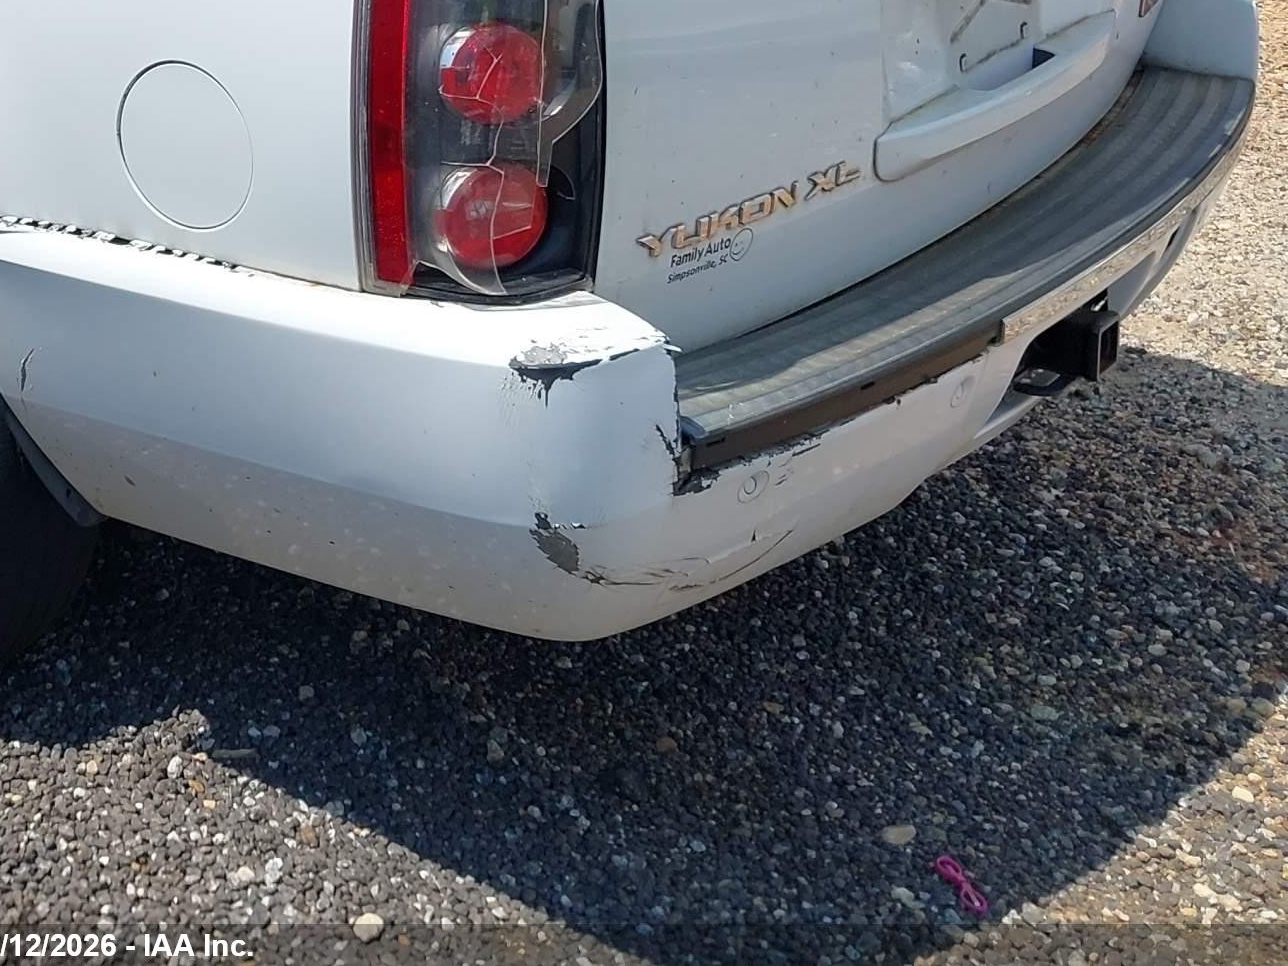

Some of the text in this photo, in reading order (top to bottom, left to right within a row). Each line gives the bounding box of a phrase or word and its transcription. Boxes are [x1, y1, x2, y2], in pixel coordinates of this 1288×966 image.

[635, 160, 862, 258] YUKON XL
[670, 236, 732, 268] Family Auto
